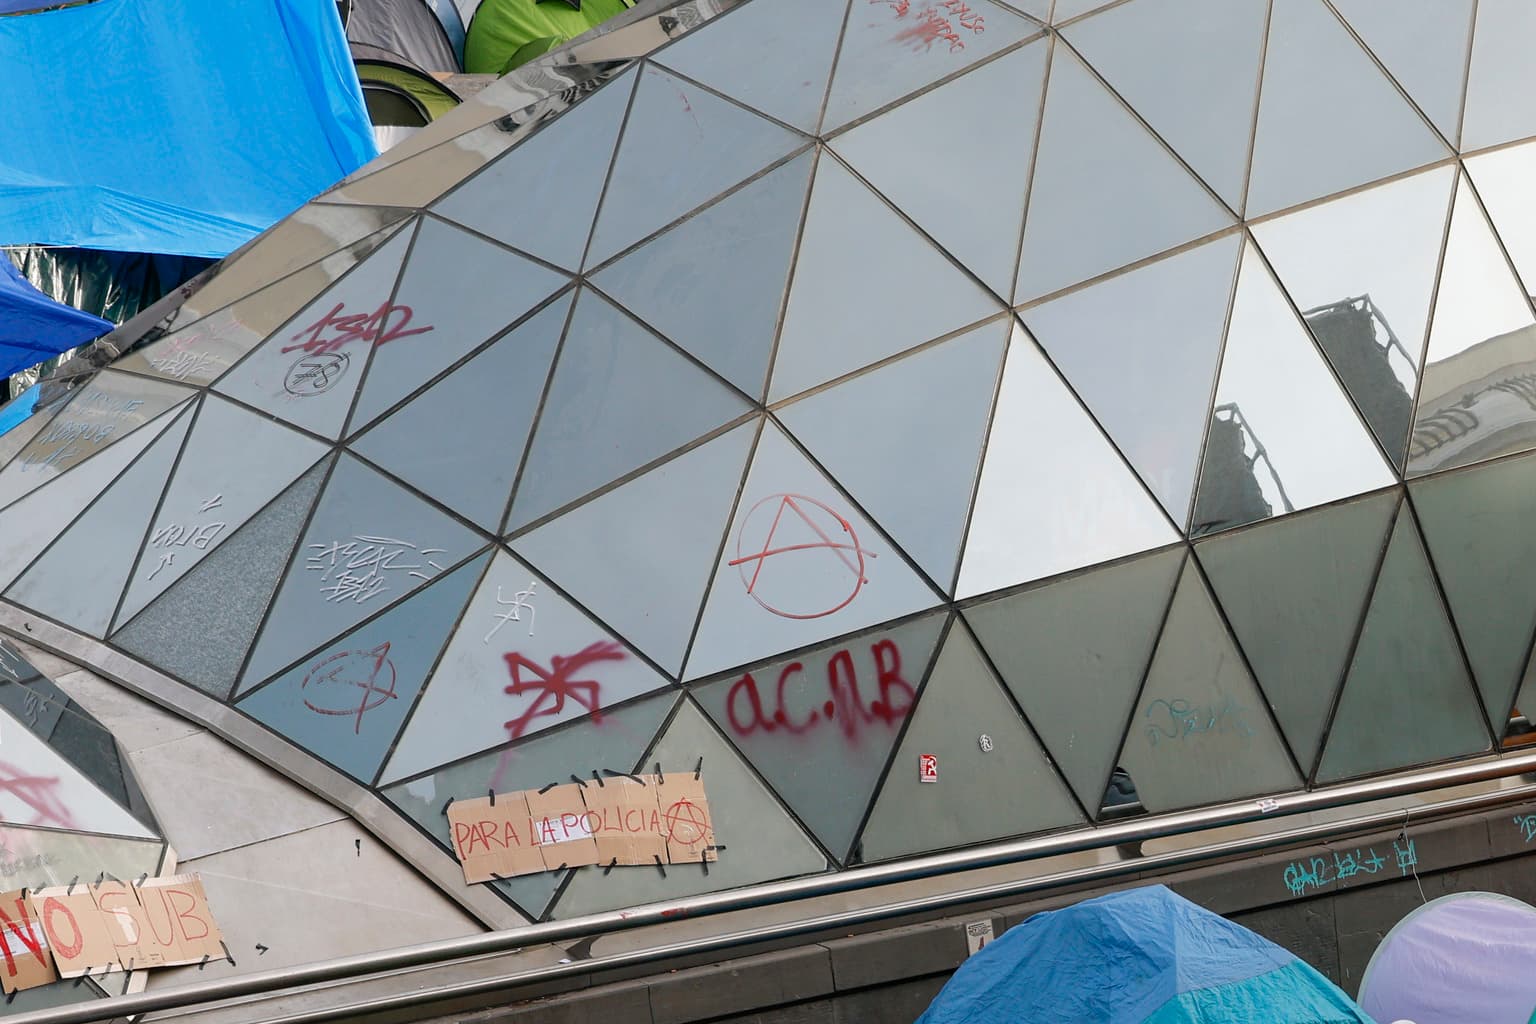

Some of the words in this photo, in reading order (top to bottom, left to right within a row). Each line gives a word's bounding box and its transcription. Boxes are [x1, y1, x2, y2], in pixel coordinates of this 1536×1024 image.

[455, 821, 521, 861] PARA
[529, 816, 557, 847] LA
[561, 805, 662, 838] POLICIA
[0, 896, 83, 978] NO
[99, 889, 209, 946] SUB
